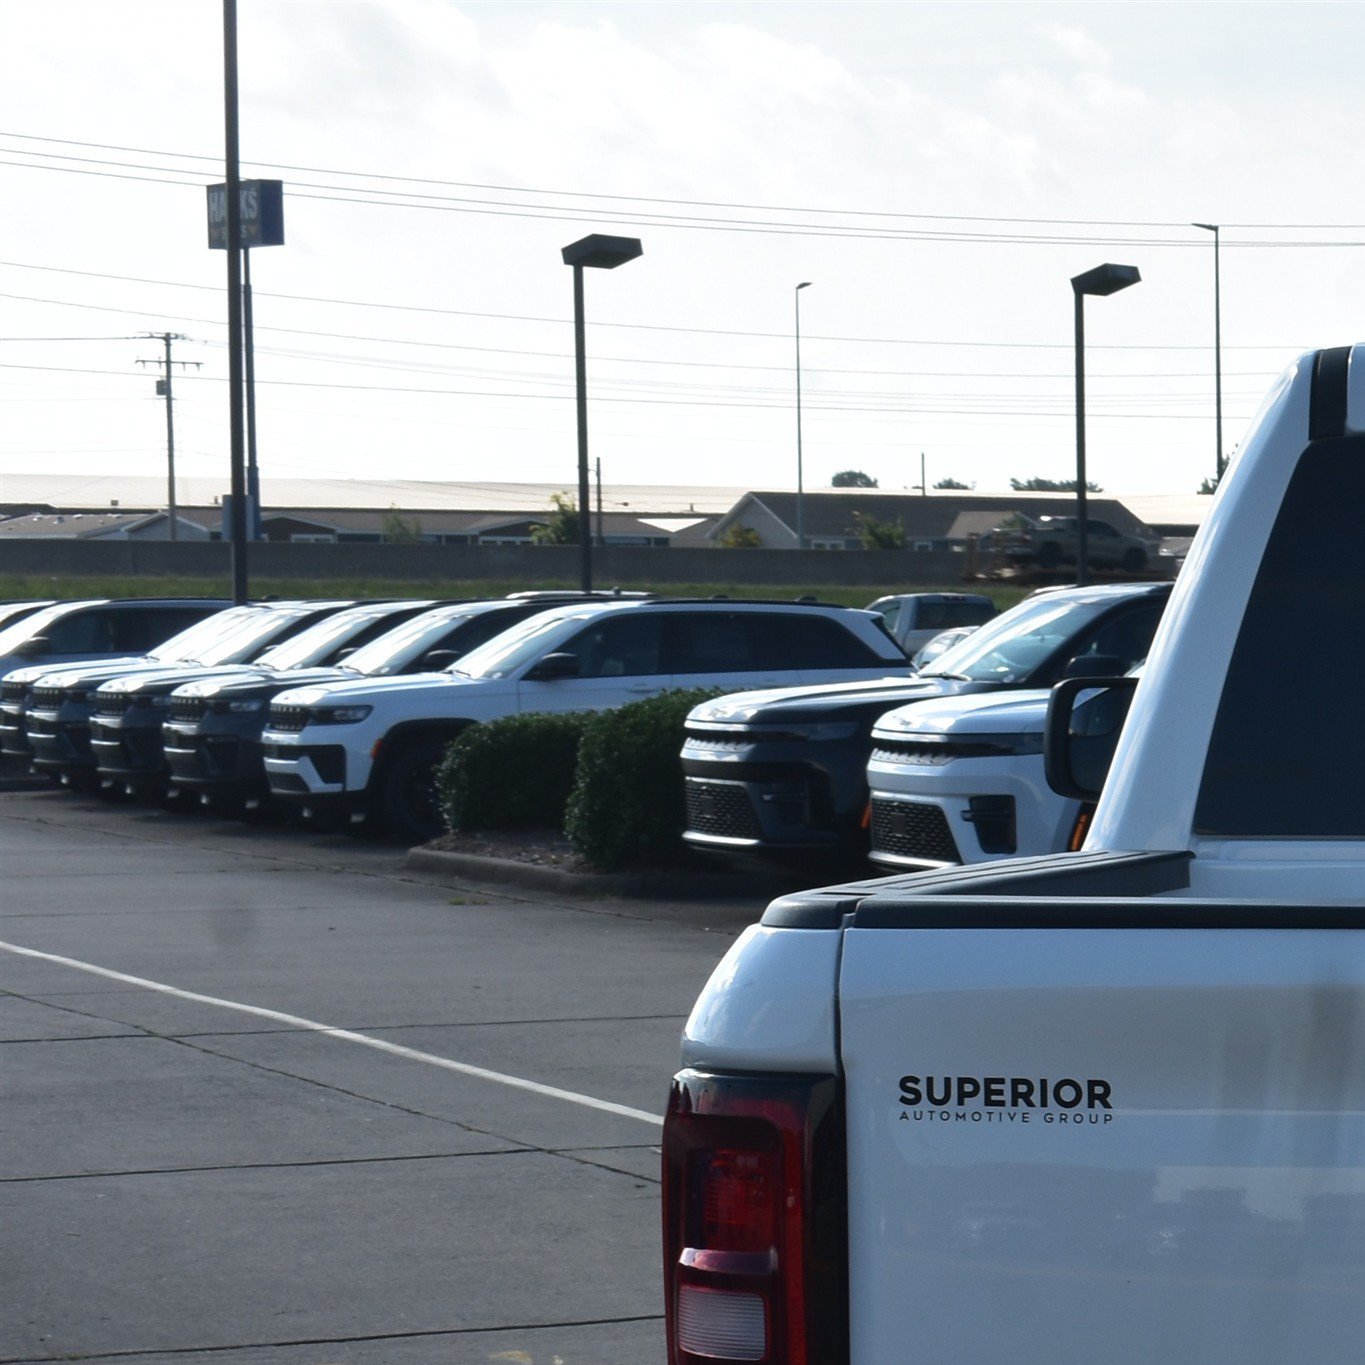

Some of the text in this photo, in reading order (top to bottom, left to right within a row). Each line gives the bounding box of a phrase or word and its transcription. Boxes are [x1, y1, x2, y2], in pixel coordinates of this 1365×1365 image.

[898, 1075, 1113, 1109] SUPERIOR
[899, 1110, 1113, 1124] AUTOMOTIVE GROUP
